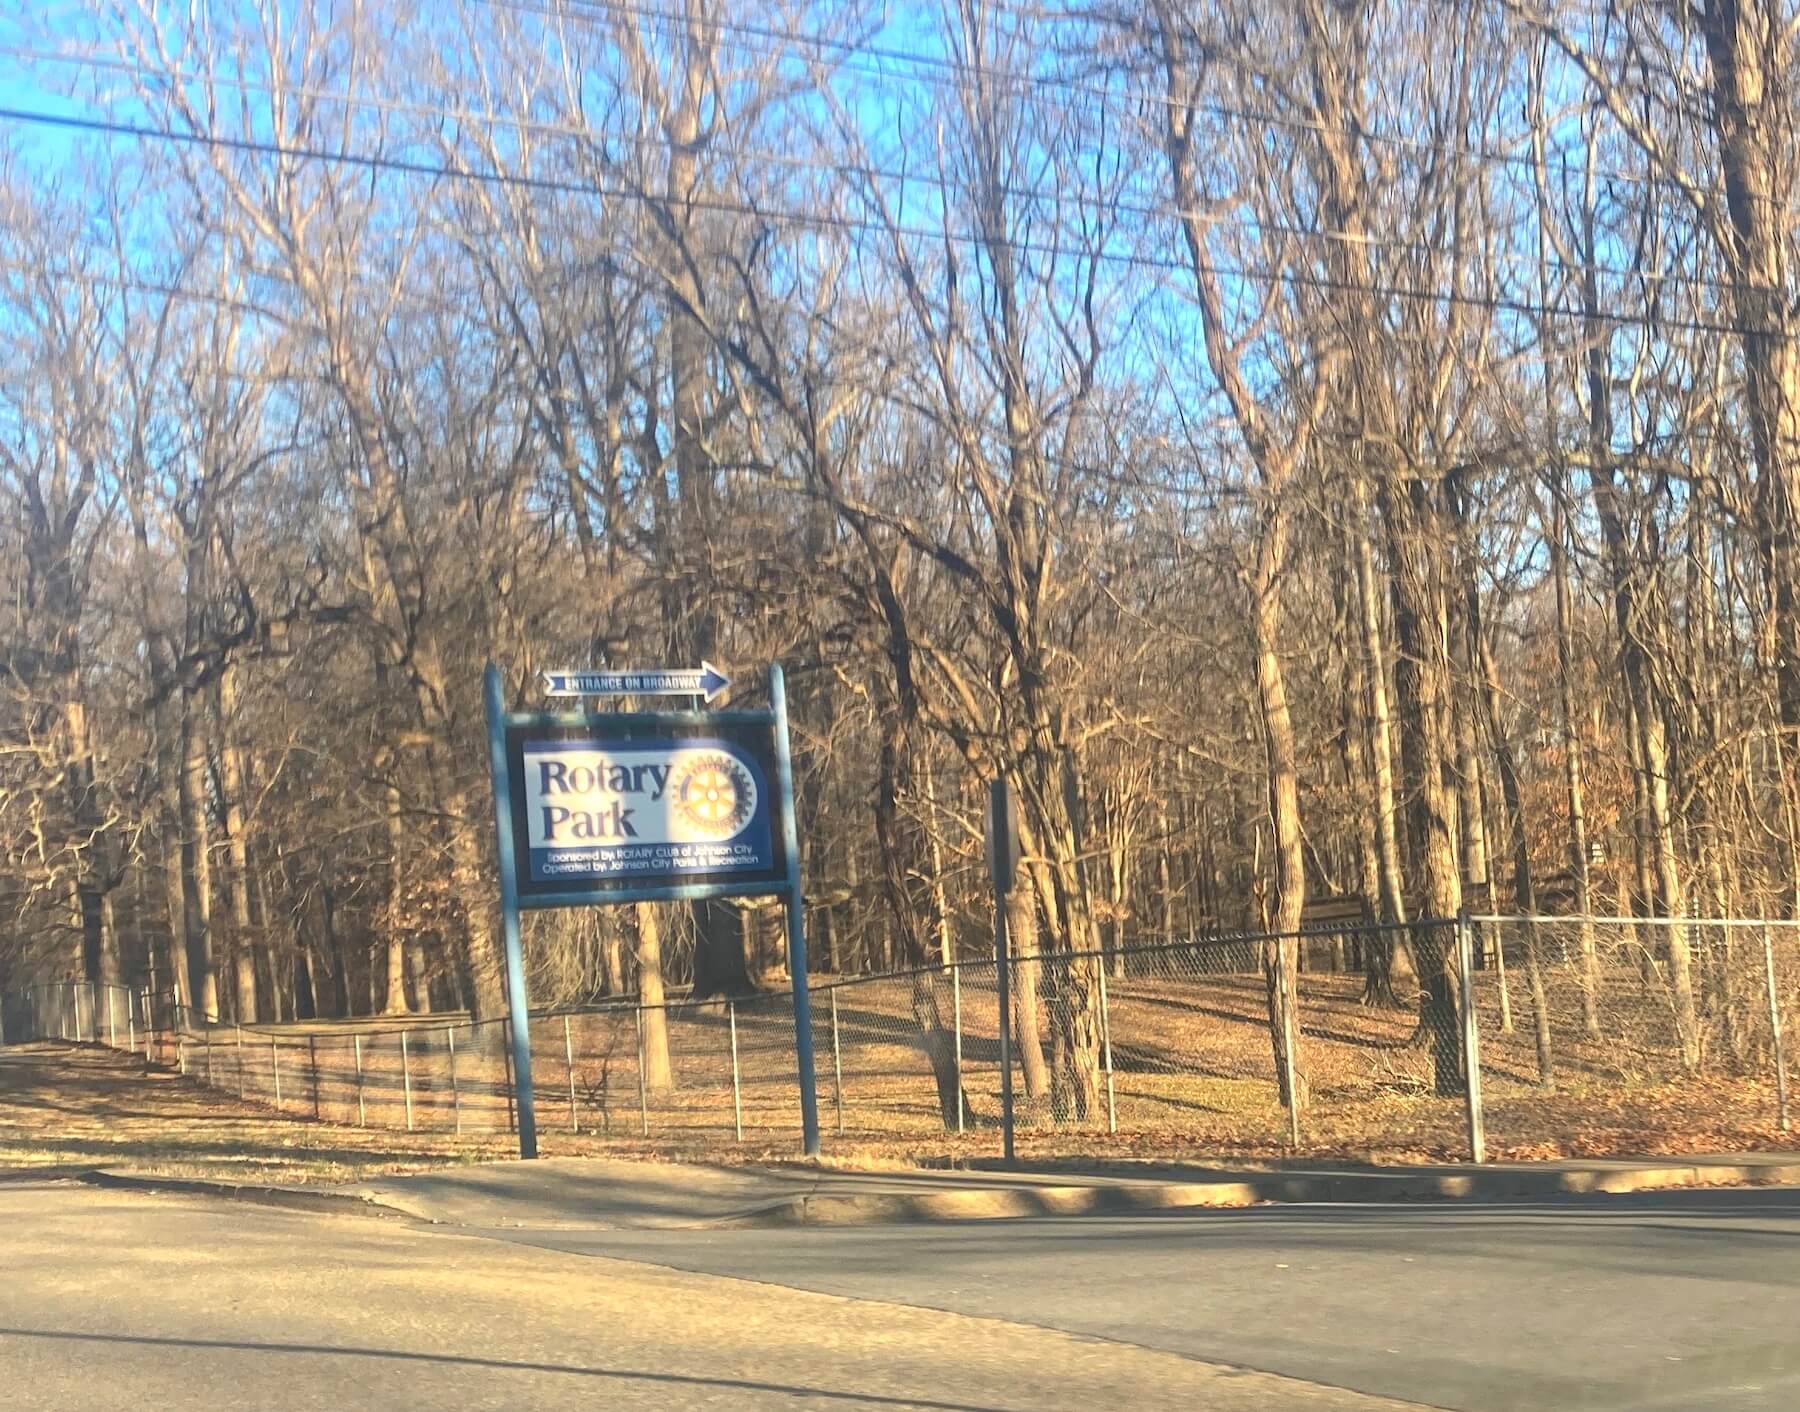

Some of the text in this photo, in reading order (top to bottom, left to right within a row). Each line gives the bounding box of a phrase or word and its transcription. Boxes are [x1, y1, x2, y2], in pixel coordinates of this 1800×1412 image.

[564, 674, 701, 690] ENTRANCE ON BROADWAY
[538, 759, 673, 801] Rotary
[541, 802, 639, 841] Park
[617, 847, 653, 860] ROTARY
[656, 847, 680, 858] CLUB
[681, 845, 692, 857] of
[693, 845, 732, 857] Johnson
[734, 844, 753, 856] City
[542, 862, 592, 875] Operated
[609, 859, 650, 872] Johnson
[651, 858, 671, 870] City
[709, 854, 759, 867] Recreation
